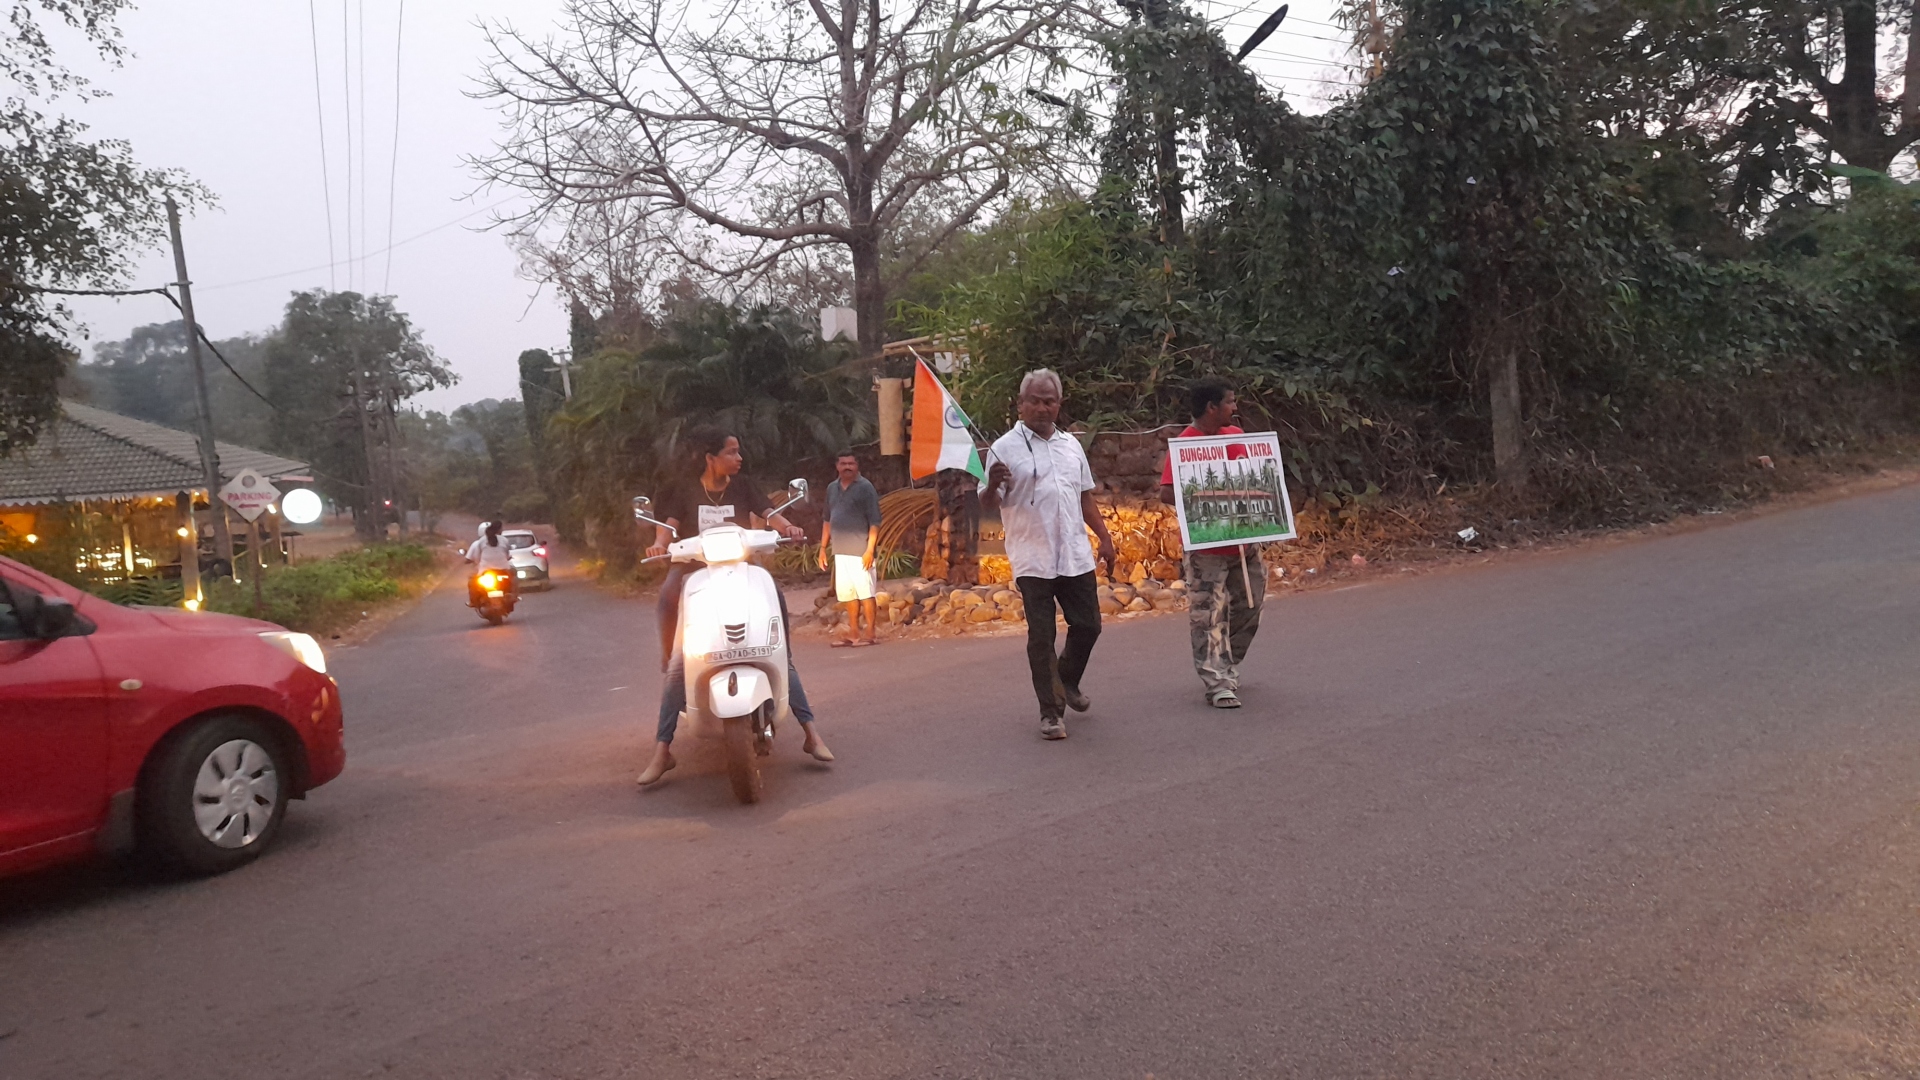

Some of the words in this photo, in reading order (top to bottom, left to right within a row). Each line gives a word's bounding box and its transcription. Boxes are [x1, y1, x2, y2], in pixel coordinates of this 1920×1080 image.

[1179, 446, 1225, 463] BUNGALOW
[1247, 443, 1273, 458] YATRA
[227, 492, 272, 501] PARKING
